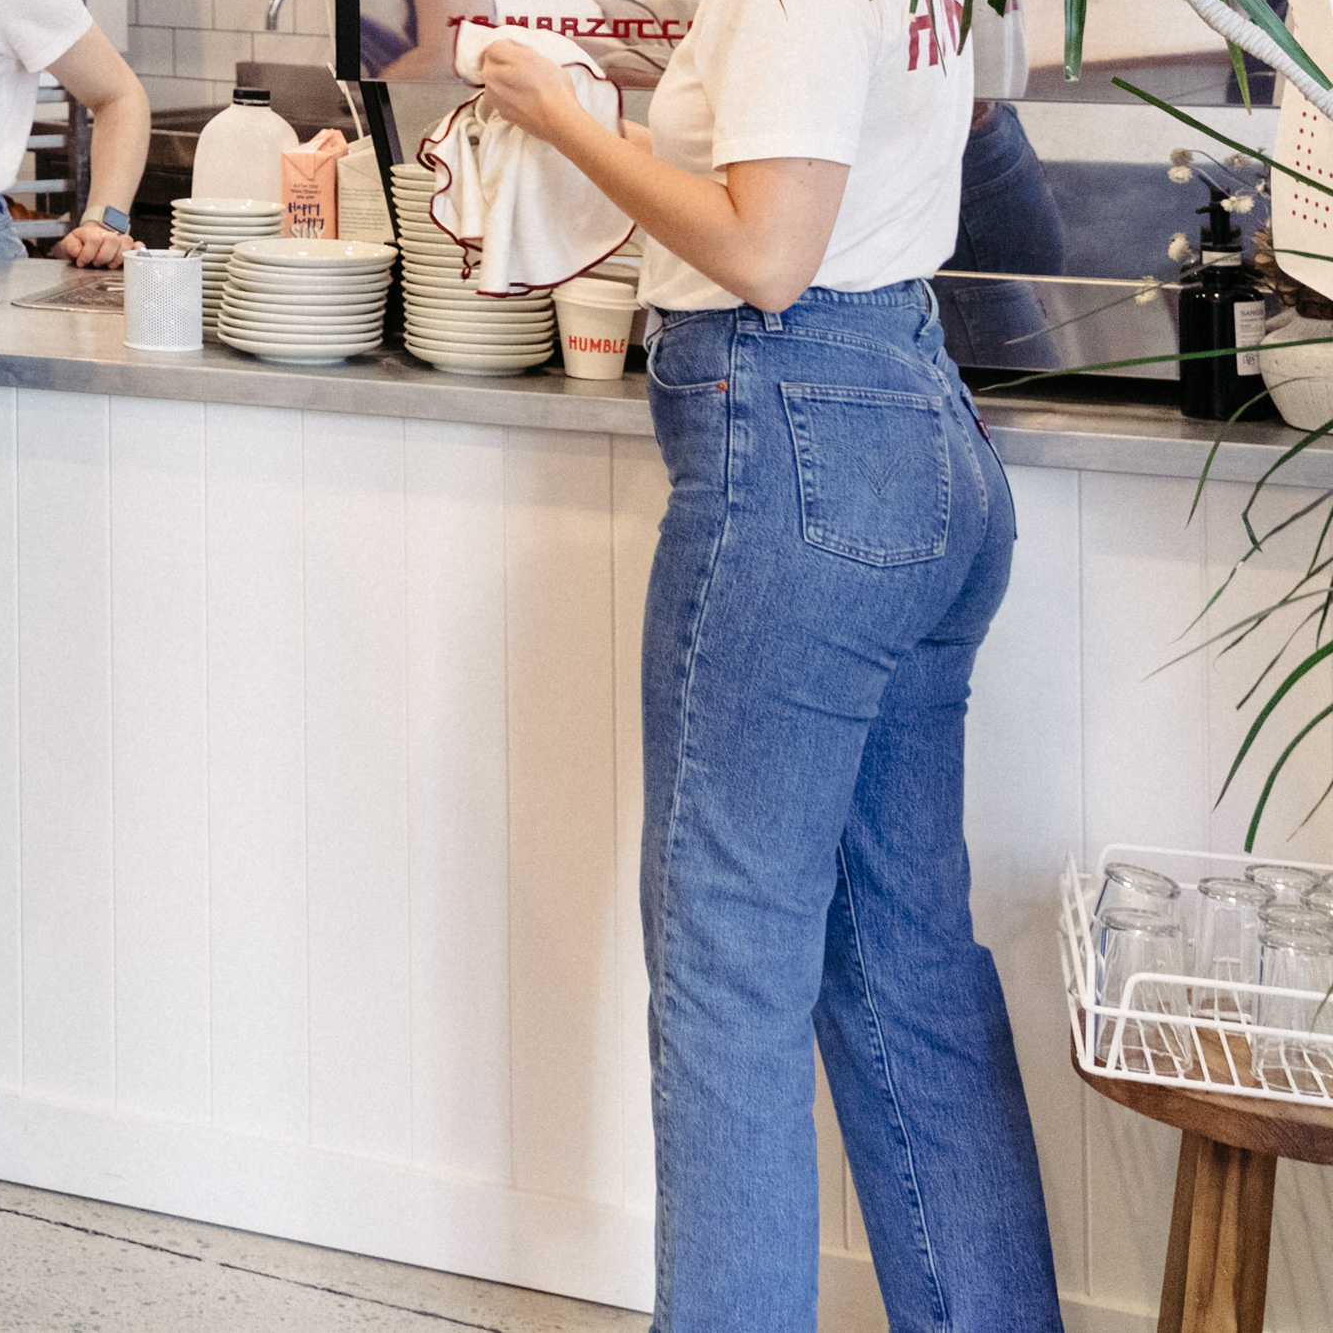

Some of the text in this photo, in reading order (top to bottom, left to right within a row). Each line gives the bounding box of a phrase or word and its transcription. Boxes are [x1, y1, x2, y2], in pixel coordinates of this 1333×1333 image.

[505, 15, 693, 40] MARZOCC
[288, 202, 320, 216] Happy
[293, 214, 324, 230] happy
[568, 334, 626, 354] HUMBLE
